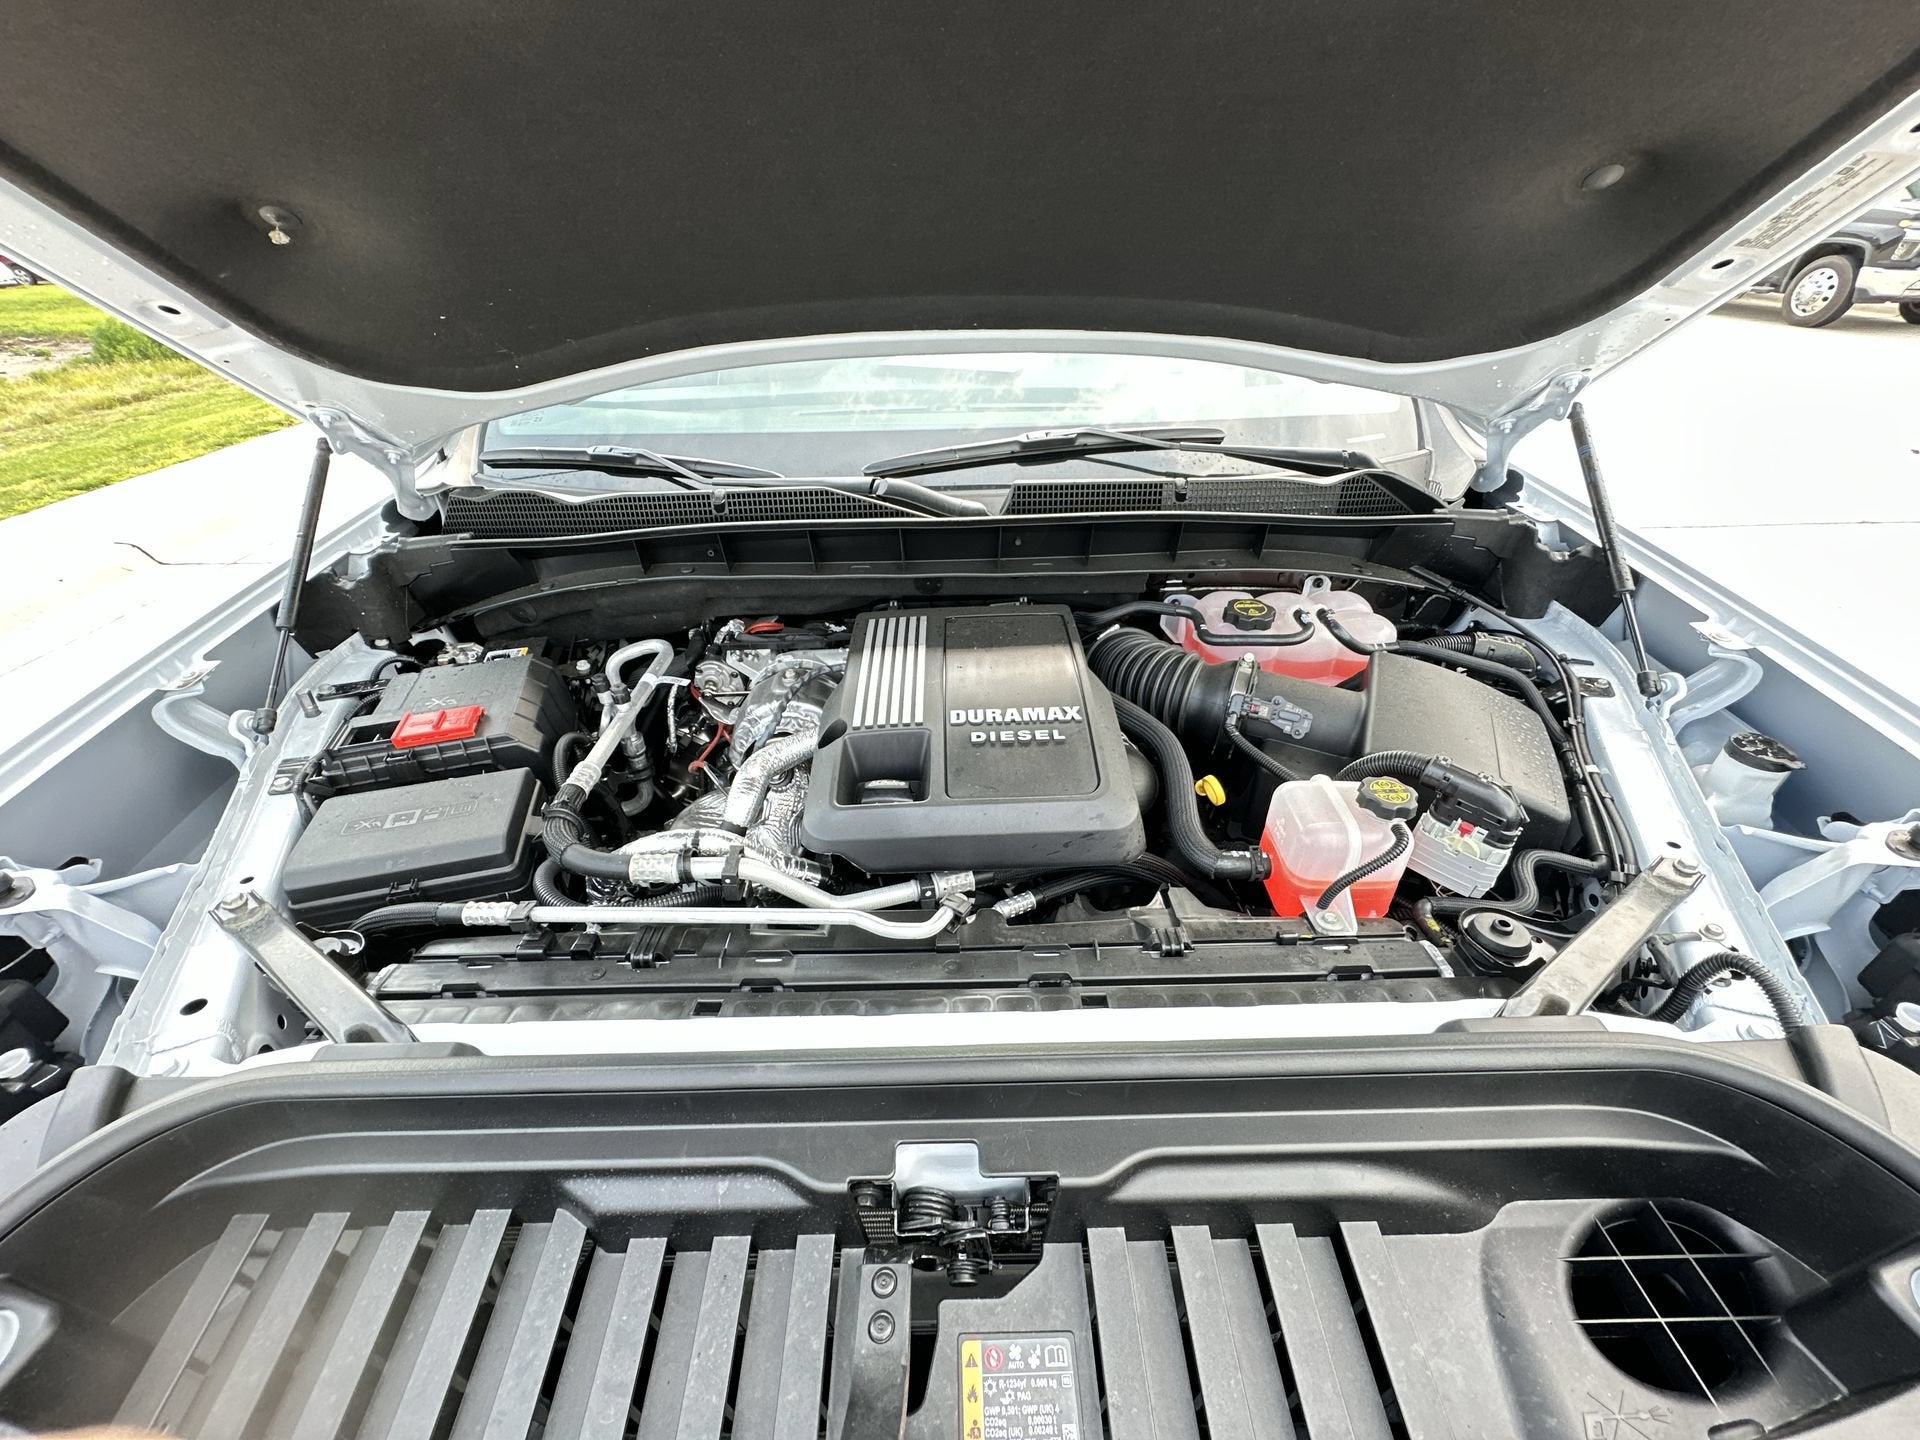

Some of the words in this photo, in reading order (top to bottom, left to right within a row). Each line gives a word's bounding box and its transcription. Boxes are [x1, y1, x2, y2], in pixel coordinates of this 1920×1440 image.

[949, 705, 1083, 725] DURAMAX
[970, 729, 1067, 744] DIESEL
[1008, 1361, 1025, 1369] AUTO
